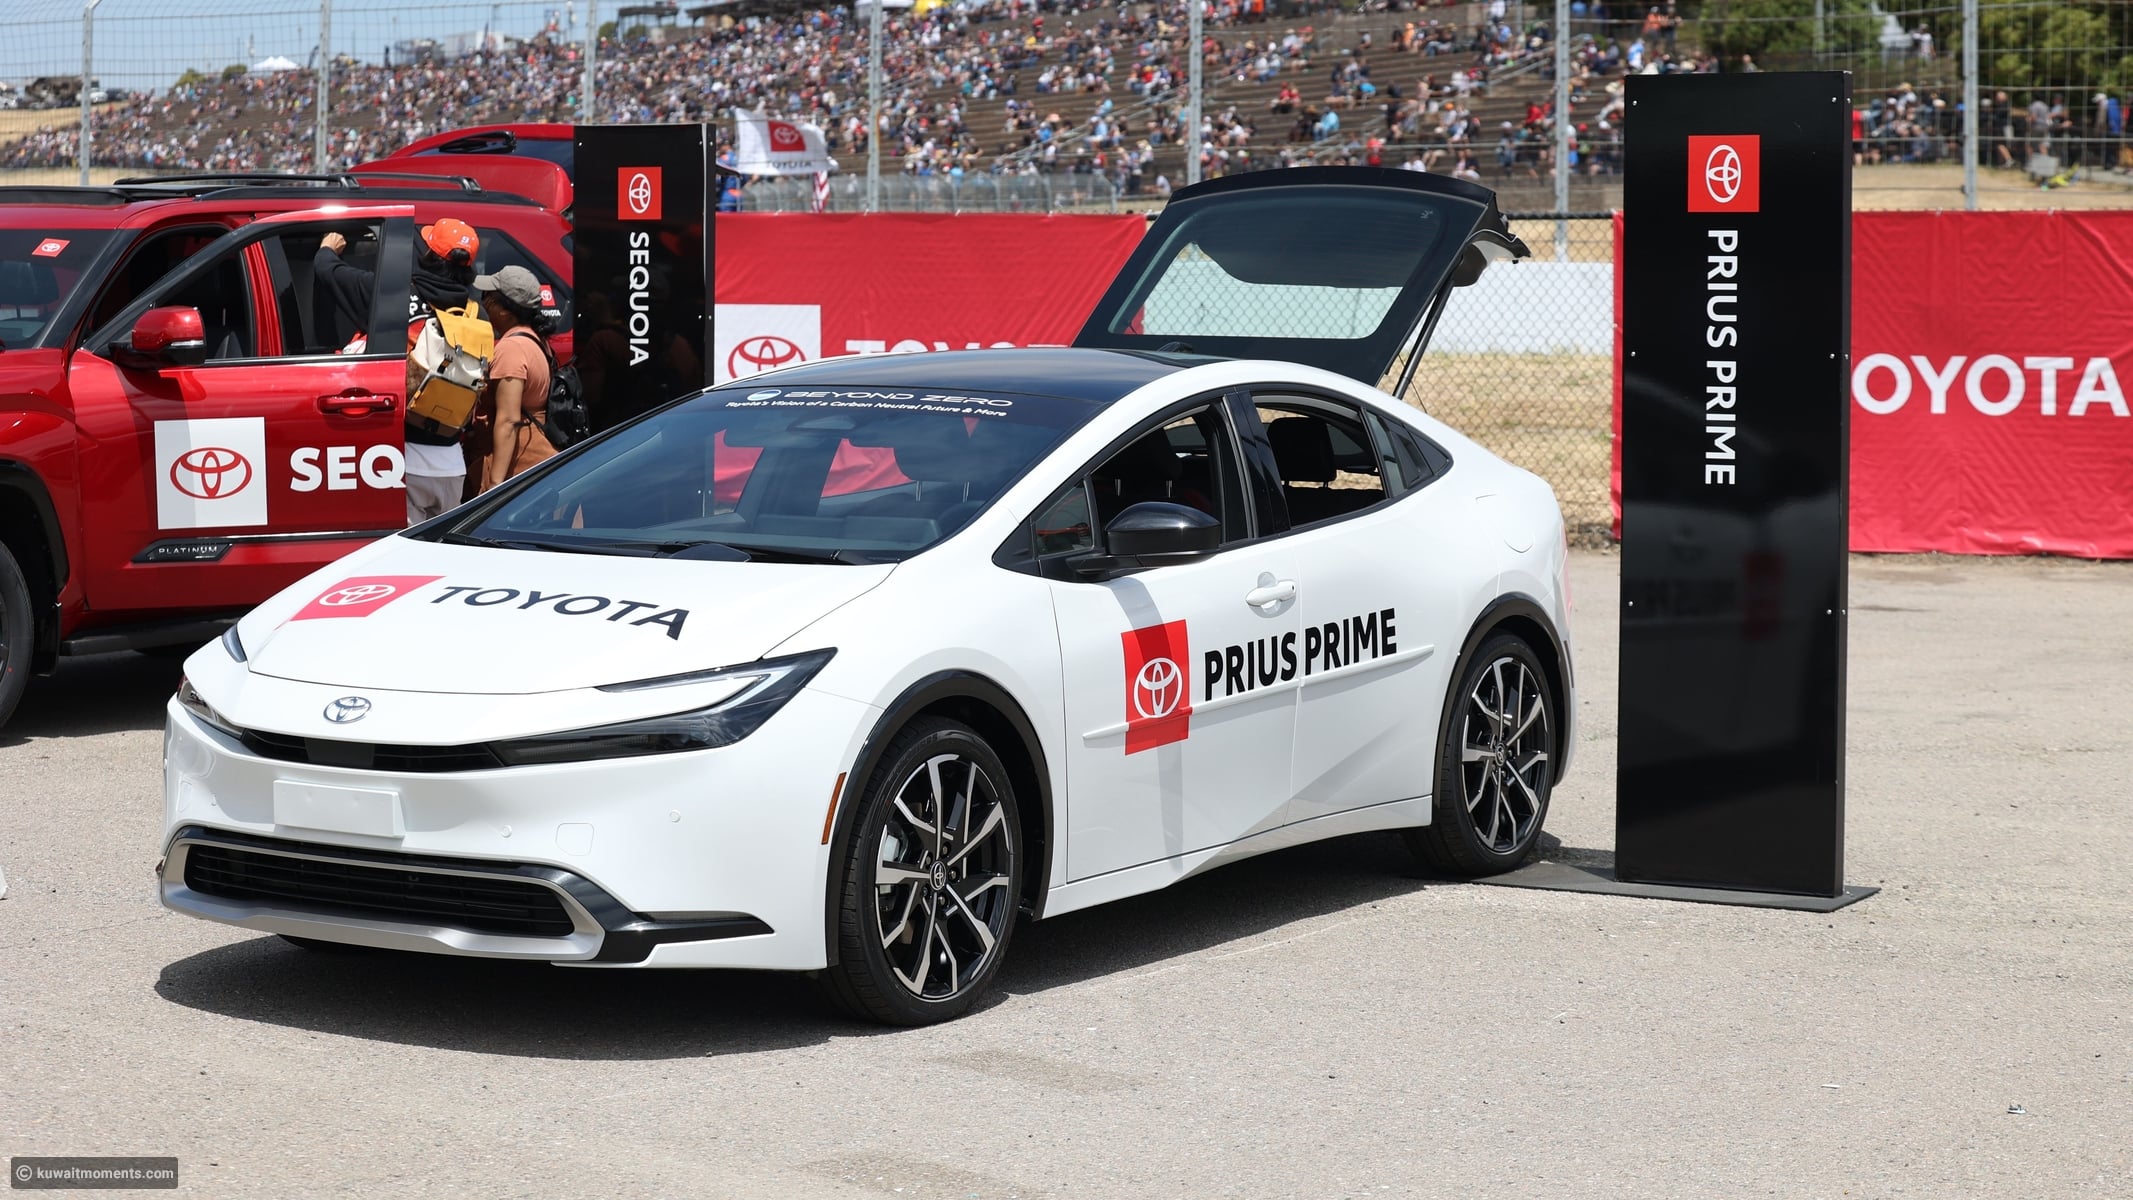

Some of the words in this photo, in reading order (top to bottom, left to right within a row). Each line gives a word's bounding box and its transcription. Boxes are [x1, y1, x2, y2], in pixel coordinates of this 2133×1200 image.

[540, 309, 562, 317] TOYOTA
[629, 231, 650, 367] SEQUOIA
[1706, 229, 1739, 348] PRIUS
[784, 391, 915, 400] BEYOND
[920, 394, 1013, 407] ZERO
[874, 402, 921, 410] Neutral
[921, 404, 961, 412] Future
[974, 408, 1007, 417] More
[1852, 353, 2131, 417] OYOTA
[1704, 360, 1738, 485] PRIME
[159, 546, 218, 555] PLATINUM
[430, 586, 690, 641] TOYOTA
[1205, 631, 1298, 702] PRIUS
[1305, 607, 1397, 676] PRIME
